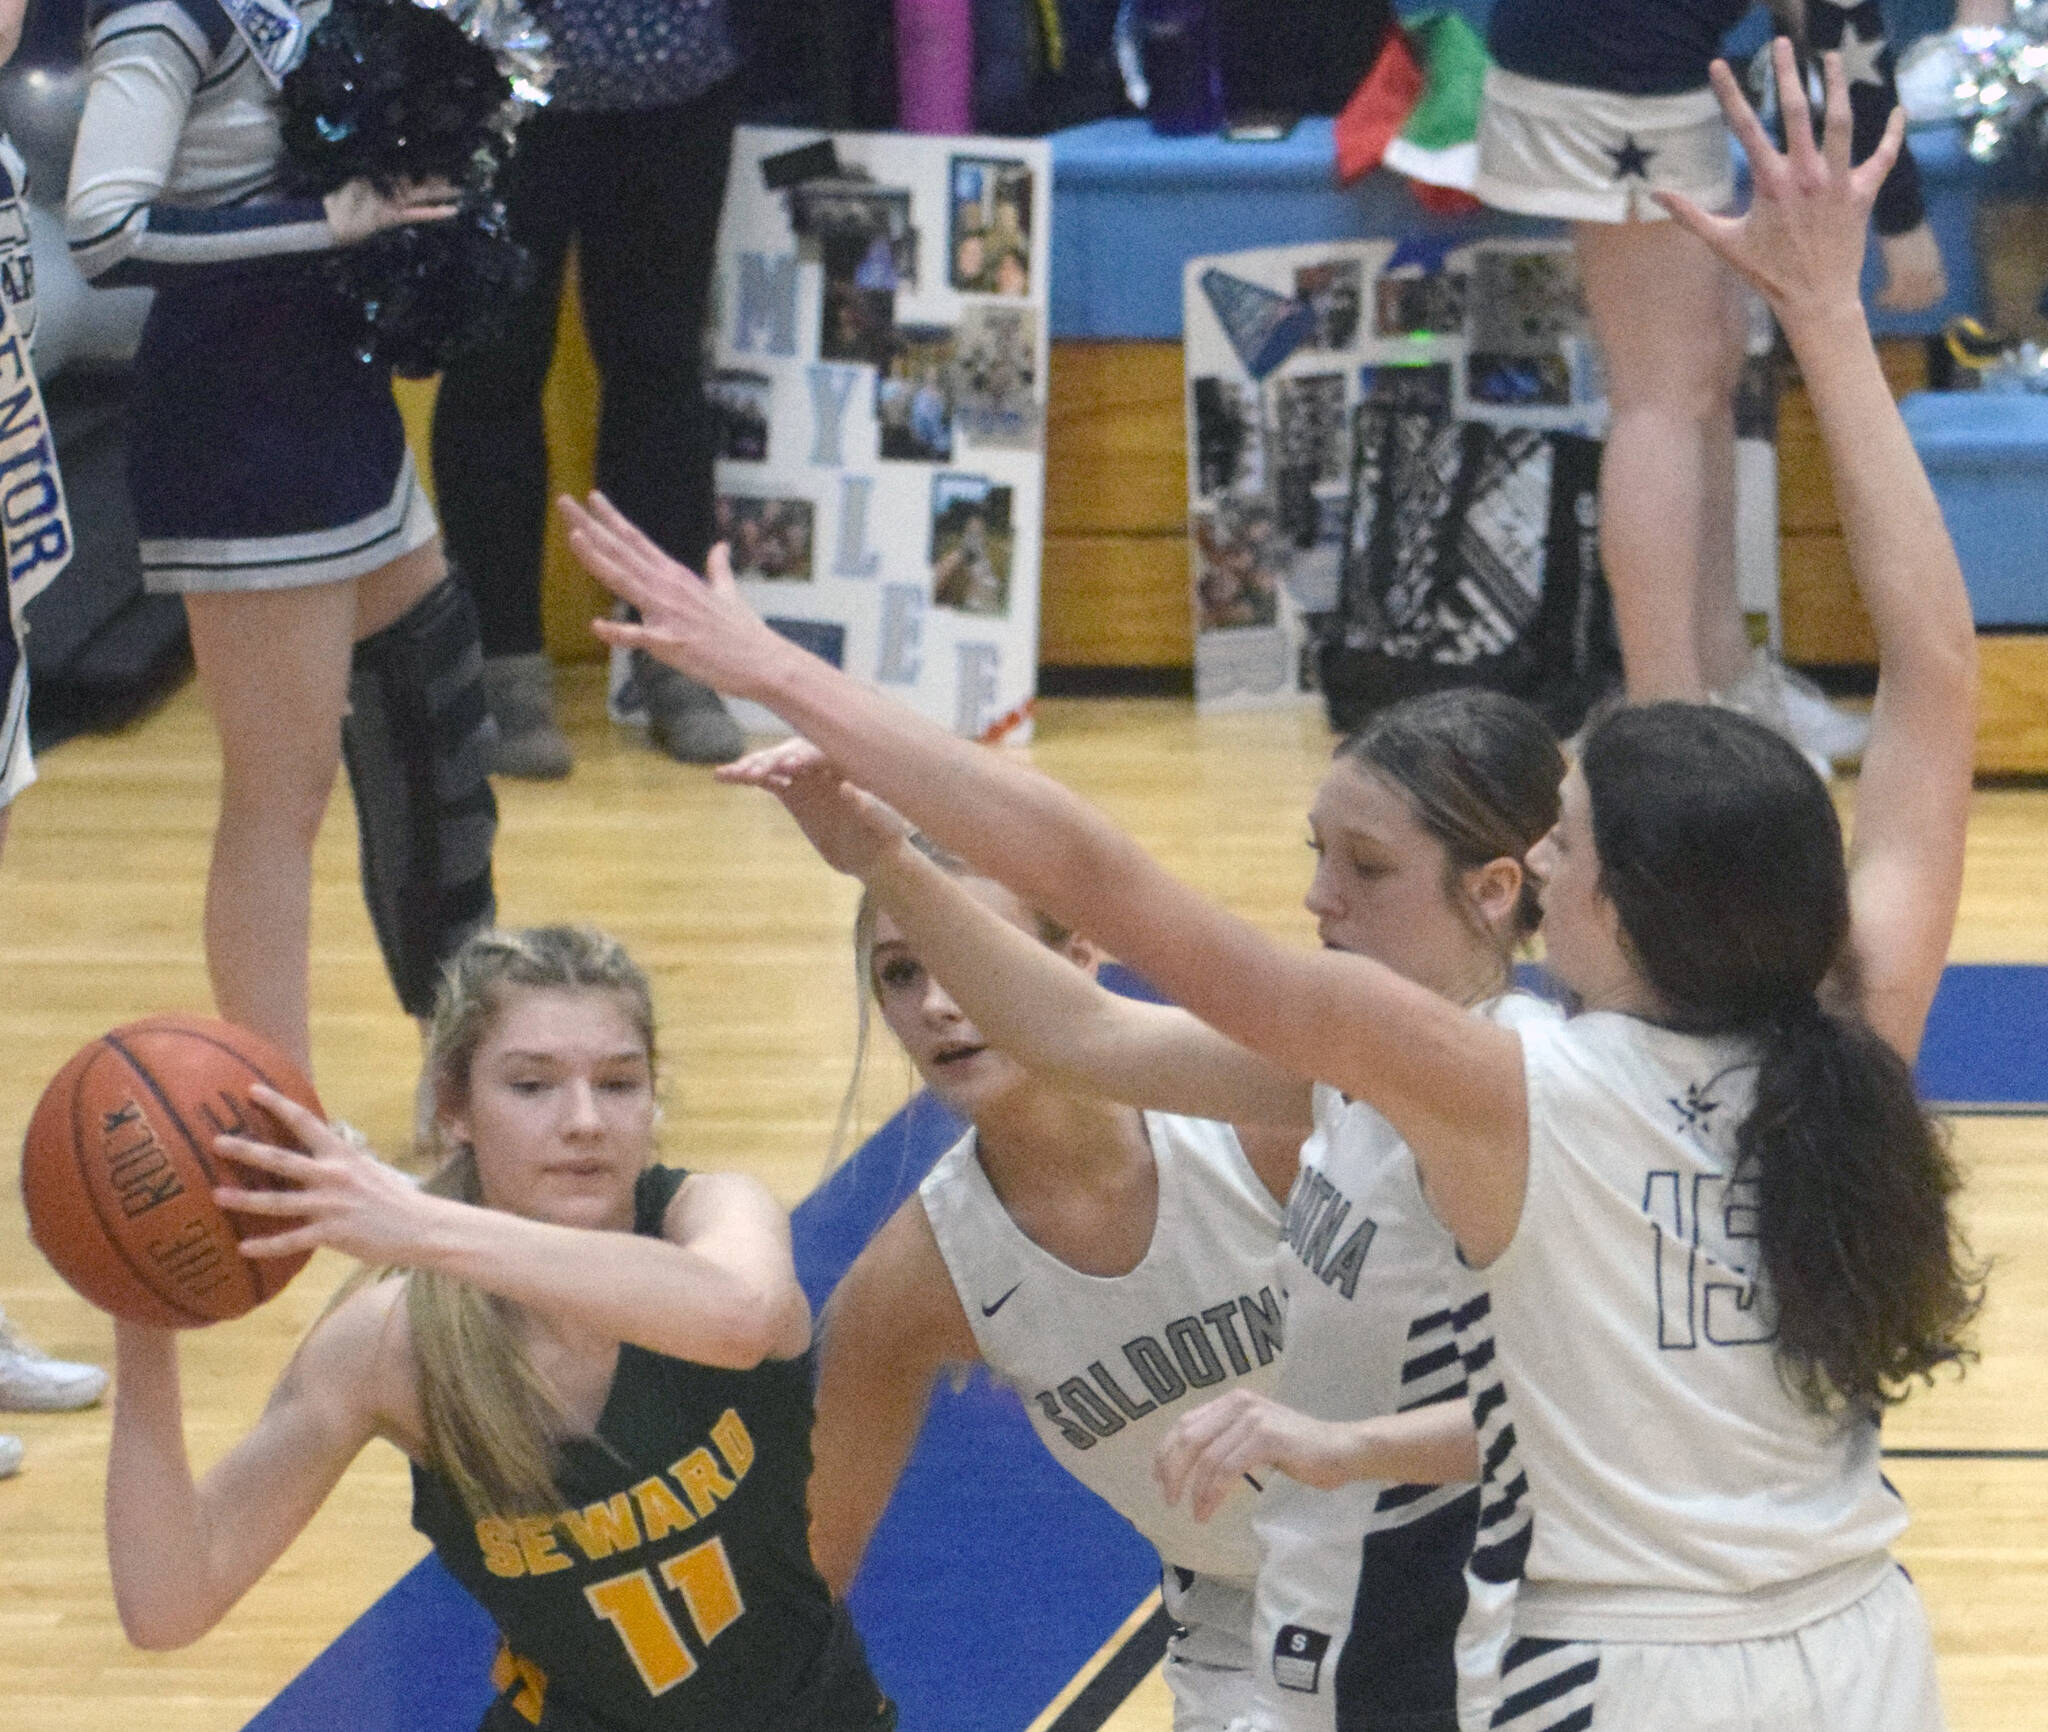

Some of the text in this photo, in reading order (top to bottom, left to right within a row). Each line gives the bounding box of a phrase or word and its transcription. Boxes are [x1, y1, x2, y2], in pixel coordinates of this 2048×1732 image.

[0, 305, 69, 586] NIOR
[102, 1098, 186, 1219] ROCK
[1035, 1286, 1289, 1450] SOLDOTN
[475, 1408, 755, 1578] SEWARD
[583, 1536, 746, 1698] 11
[1290, 1633, 1307, 1652] S
